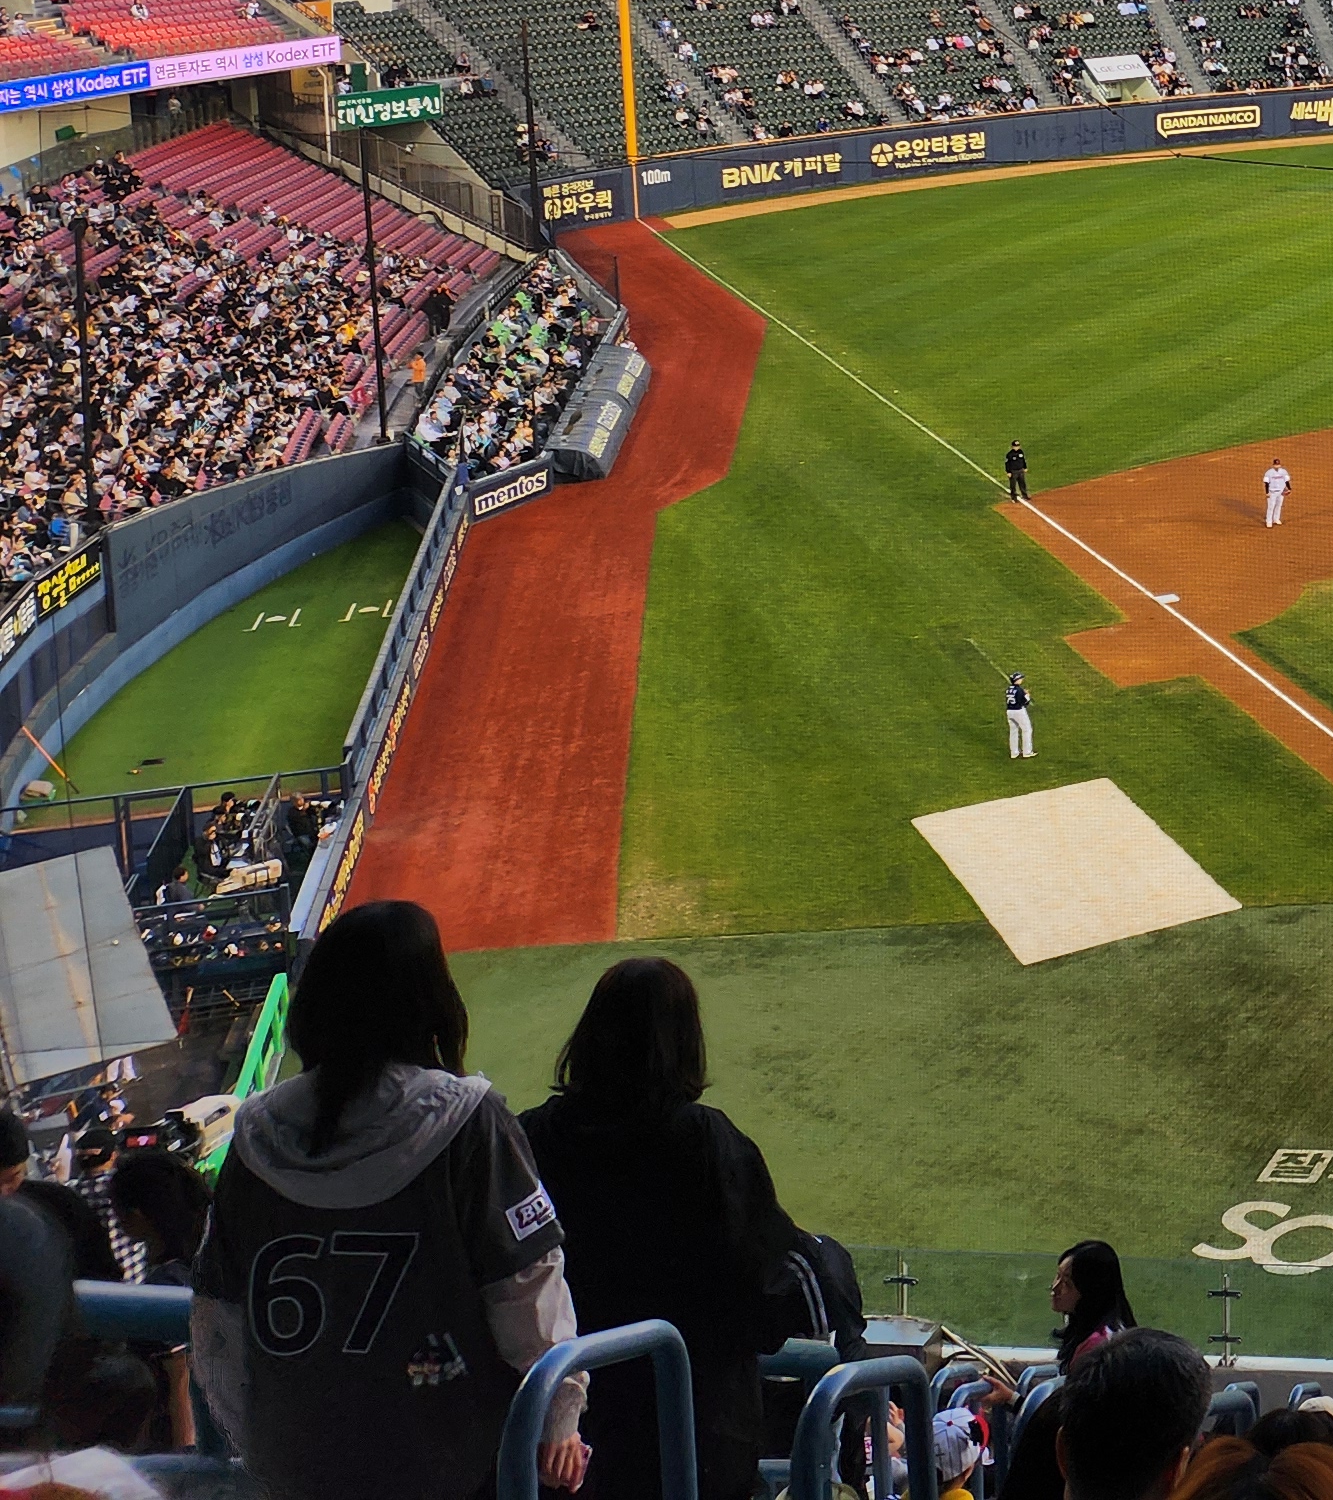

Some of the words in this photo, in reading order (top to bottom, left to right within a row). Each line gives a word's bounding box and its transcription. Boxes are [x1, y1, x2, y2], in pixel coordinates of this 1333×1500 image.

[154, 58, 213, 80] 연금투자도
[215, 55, 239, 73] 역시
[242, 52, 264, 70] 삼성
[266, 47, 310, 66] Kodex
[312, 42, 336, 59] ETF
[1092, 62, 1143, 75] LGE.COM
[24, 83, 48, 102] 역시
[52, 78, 74, 98] 삼성
[76, 72, 120, 94] Kodex
[122, 68, 148, 88] ETF
[338, 96, 440, 125] 대신정보통신
[1163, 114, 1208, 130] BANDAI
[1208, 110, 1255, 126] NAMCO
[894, 131, 986, 159] 유안타증권
[641, 167, 671, 186] 100m
[721, 161, 782, 189] BNK
[784, 152, 843, 178] 캐피탈
[561, 179, 597, 196] 증권정보
[562, 189, 613, 215] 와우퀵
[475, 468, 548, 516] mentos
[1278, 1150, 1326, 1181] 잘
[247, 1229, 421, 1357] 67
